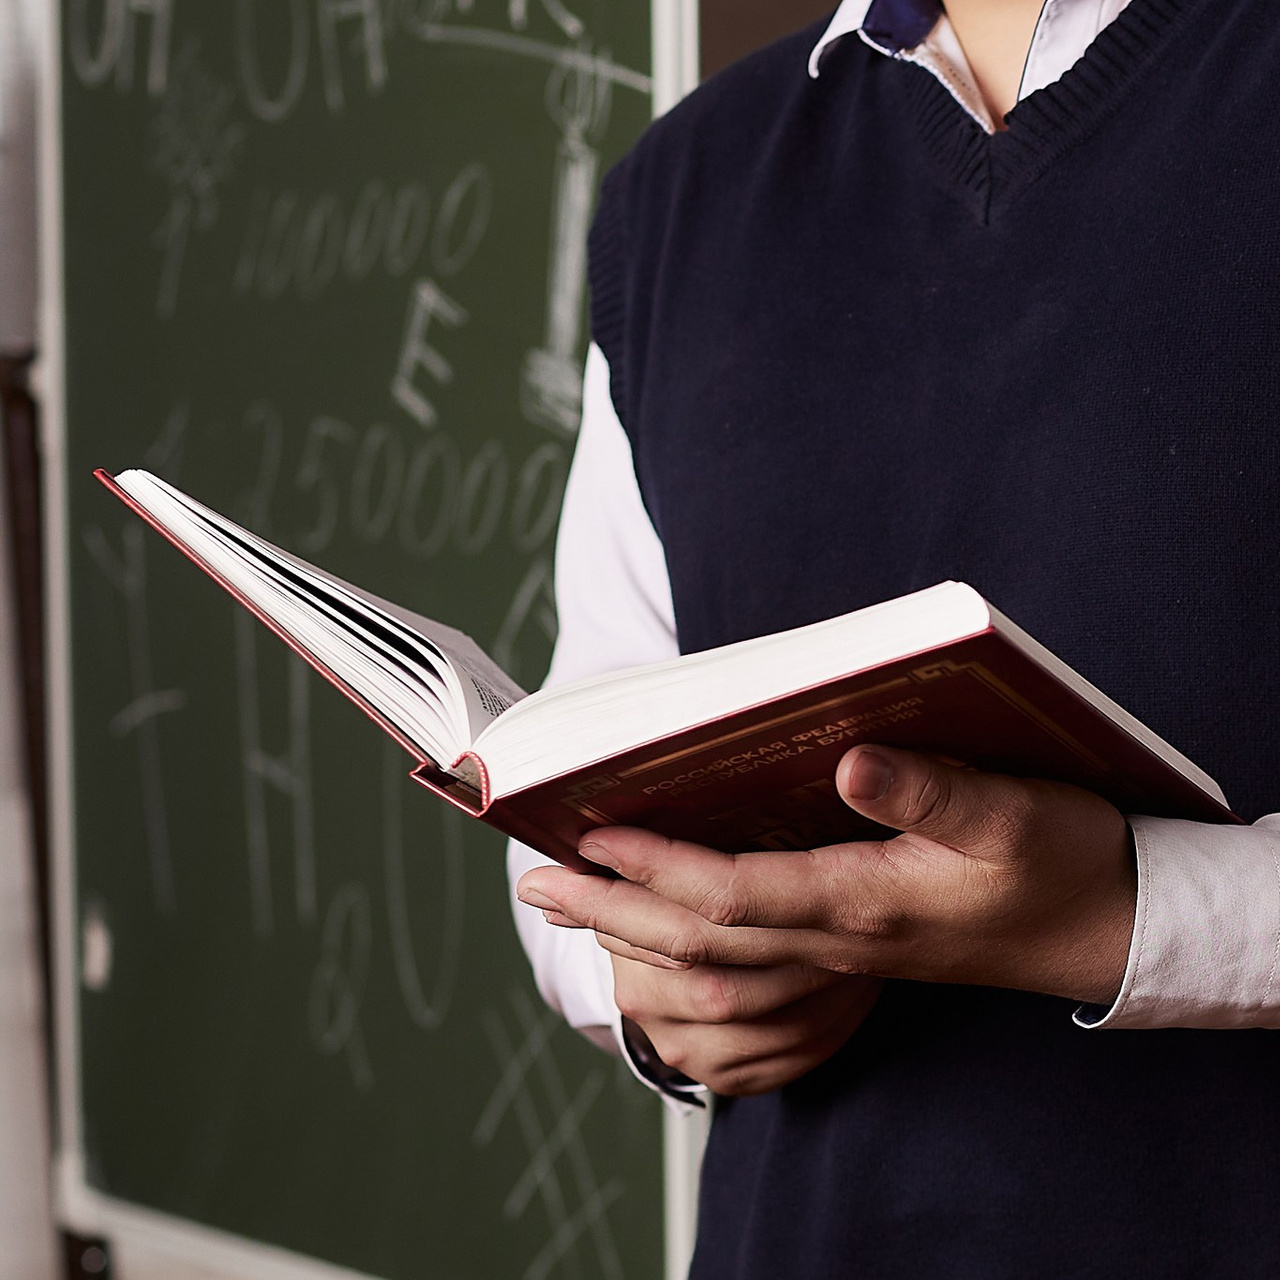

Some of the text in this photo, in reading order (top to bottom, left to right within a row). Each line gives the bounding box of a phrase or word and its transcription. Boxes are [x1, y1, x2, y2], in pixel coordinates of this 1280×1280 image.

[642, 695, 926, 796] РОССИЙСКАЯ ФЕДЕРАЦИЯ
[666, 708, 924, 799] РЕСПУБЛИКА БУРЯТИЯ
